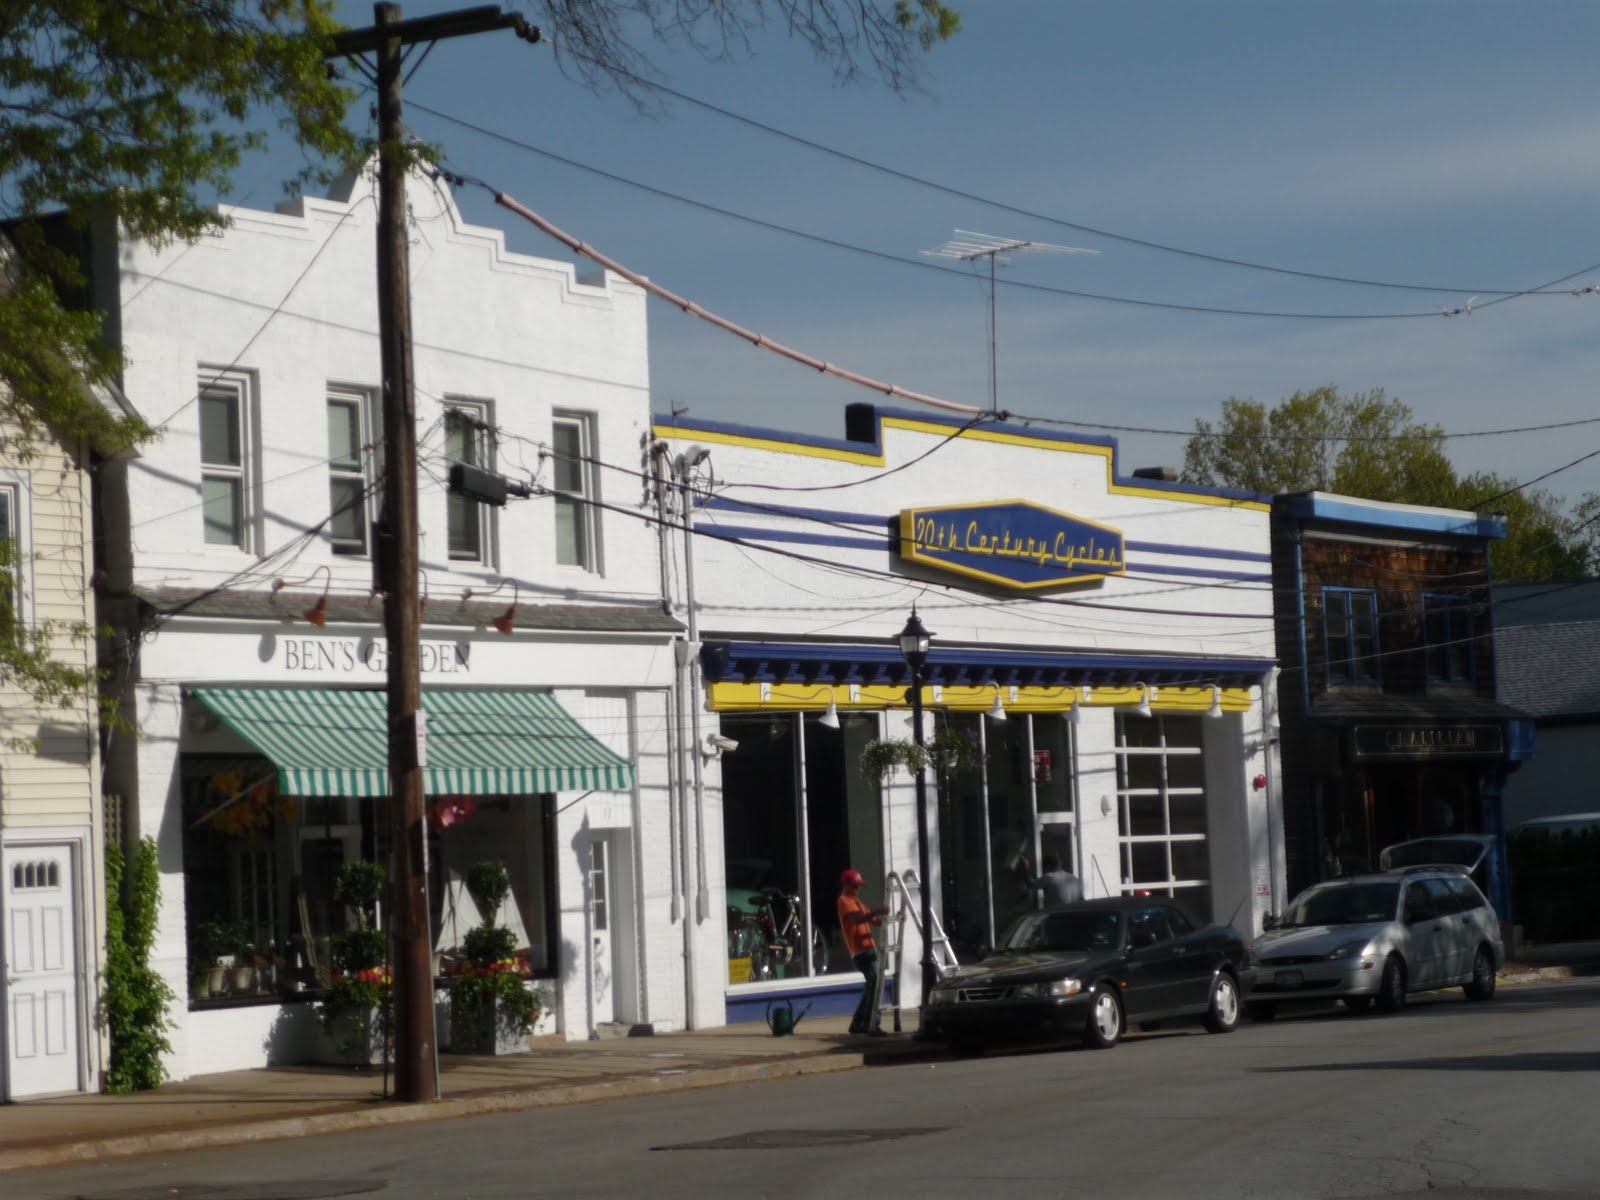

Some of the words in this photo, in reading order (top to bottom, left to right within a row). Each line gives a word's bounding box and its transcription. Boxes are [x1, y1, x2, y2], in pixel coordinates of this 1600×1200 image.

[916, 517, 964, 551] 20th
[966, 521, 1053, 568] Century
[1054, 531, 1123, 569] Cycles
[284, 639, 355, 672] BEN'S
[363, 642, 471, 673] GDEN
